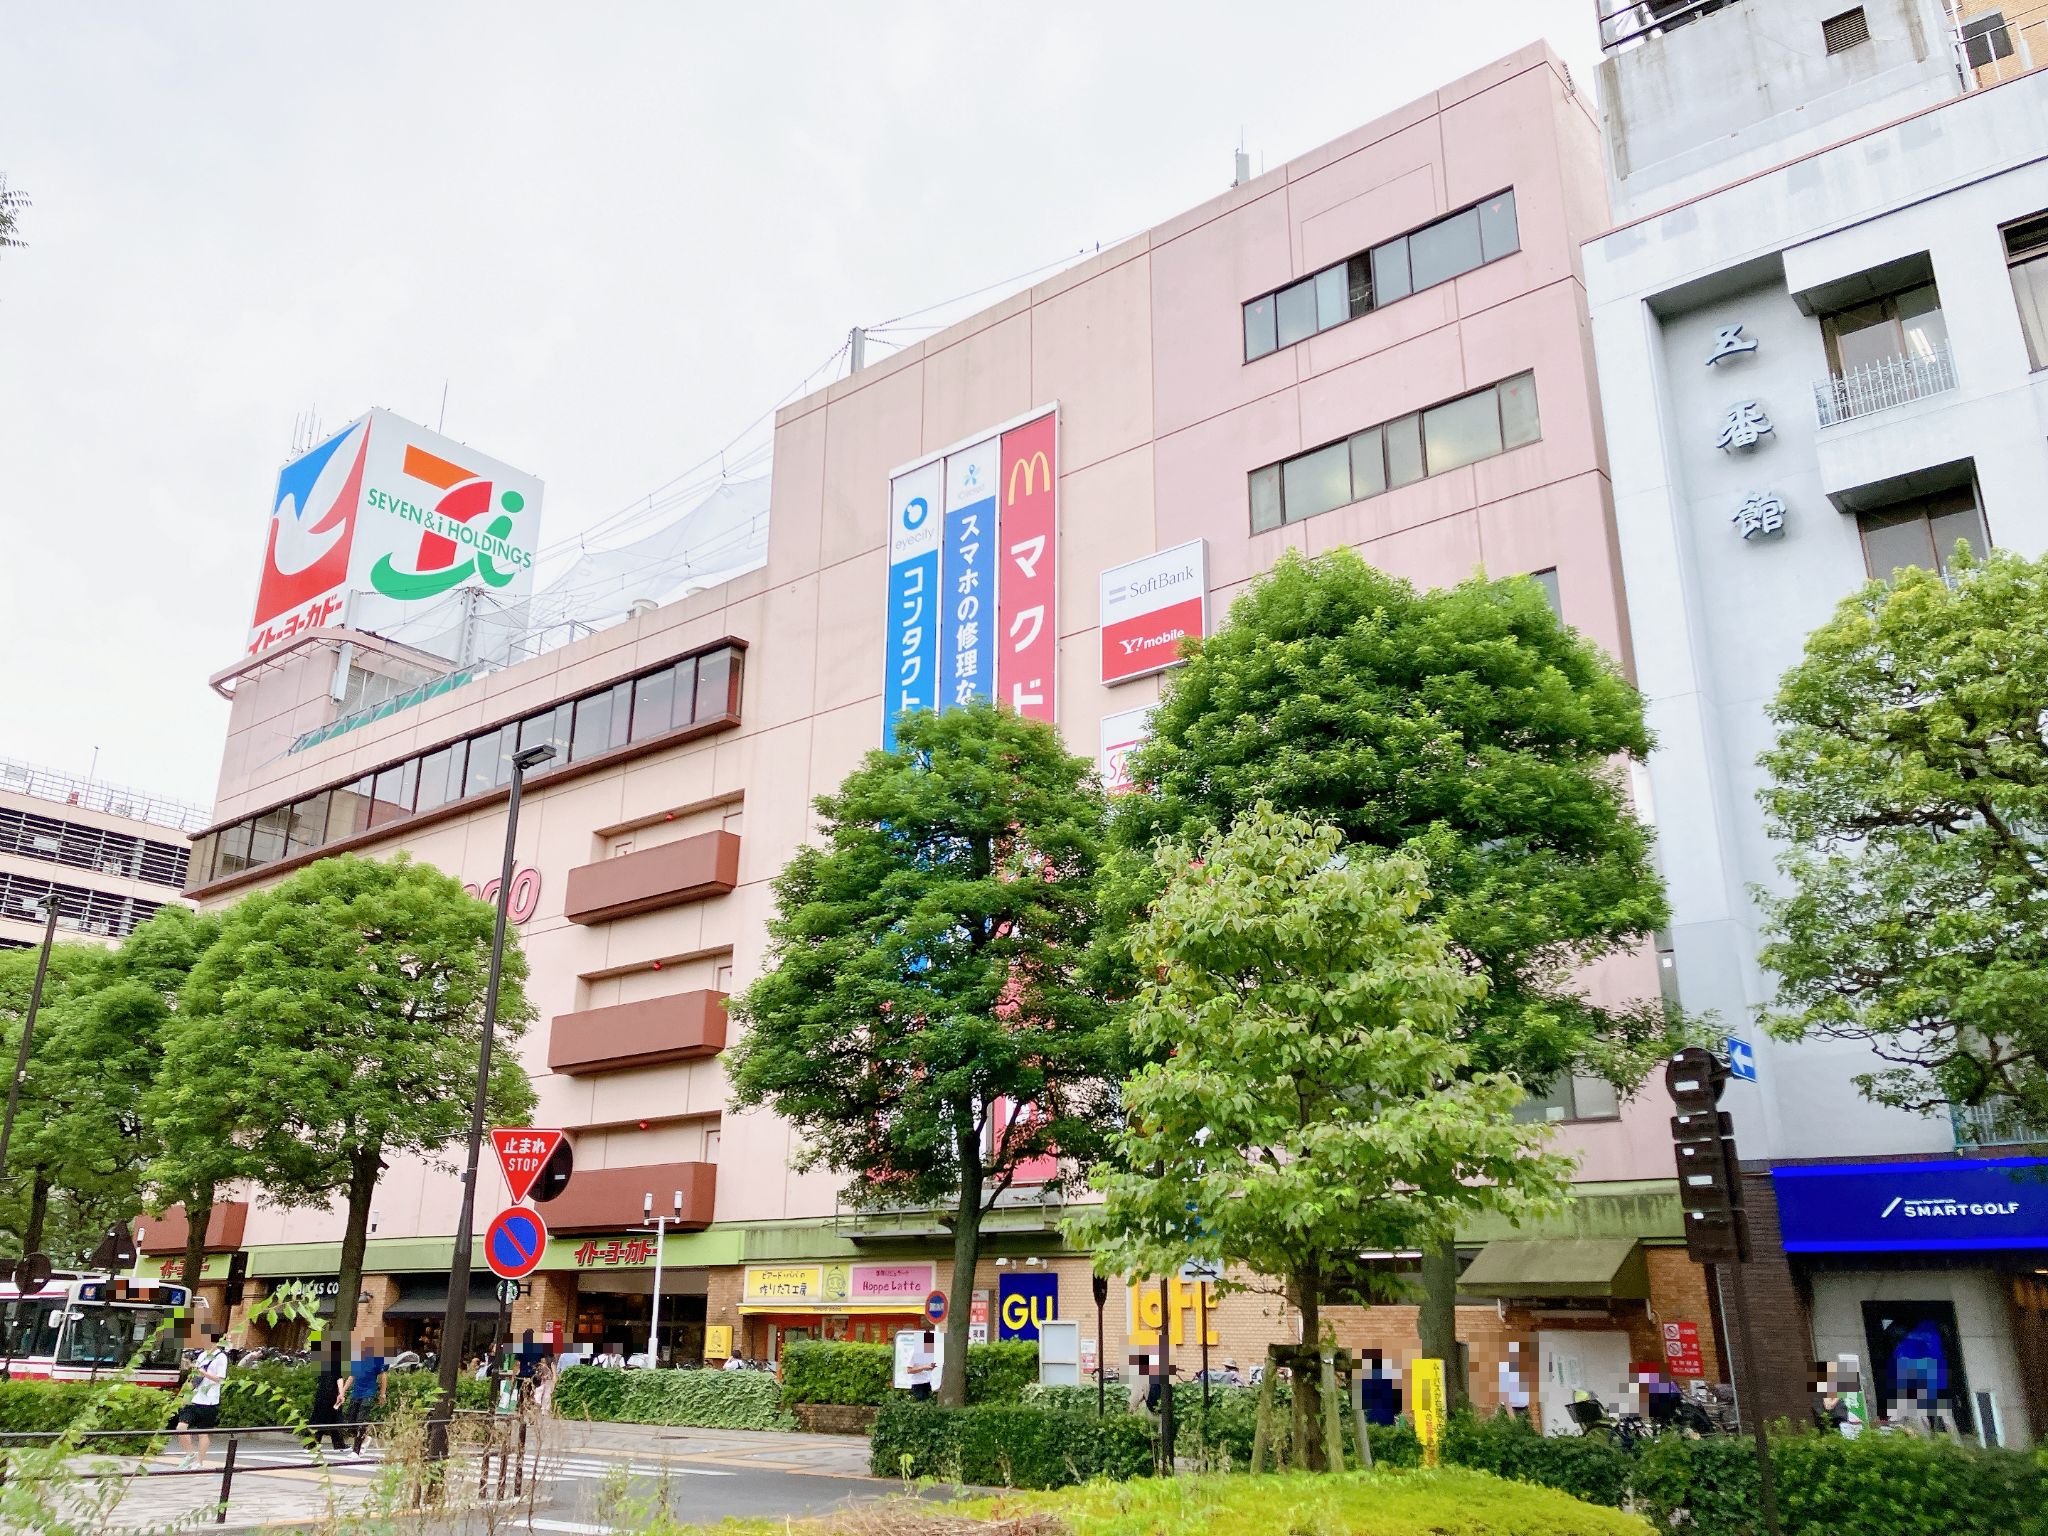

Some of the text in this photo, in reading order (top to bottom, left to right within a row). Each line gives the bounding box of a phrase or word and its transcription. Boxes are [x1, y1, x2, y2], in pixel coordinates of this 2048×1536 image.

[447, 520, 532, 569] HOLDINGS
[895, 527, 935, 551] eyecity
[1129, 566, 1194, 598] SoftBank
[248, 594, 344, 655] イトーヨーカドー
[901, 567, 924, 712] コンタクト
[502, 1137, 546, 1154] 止まれ
[508, 1158, 539, 1172] STOP
[575, 1238, 659, 1266] イトーヨーカドー
[759, 1282, 808, 1297] 作りたて工房
[862, 1280, 921, 1294] Hoppe Latte
[1002, 1293, 1053, 1331] GU
